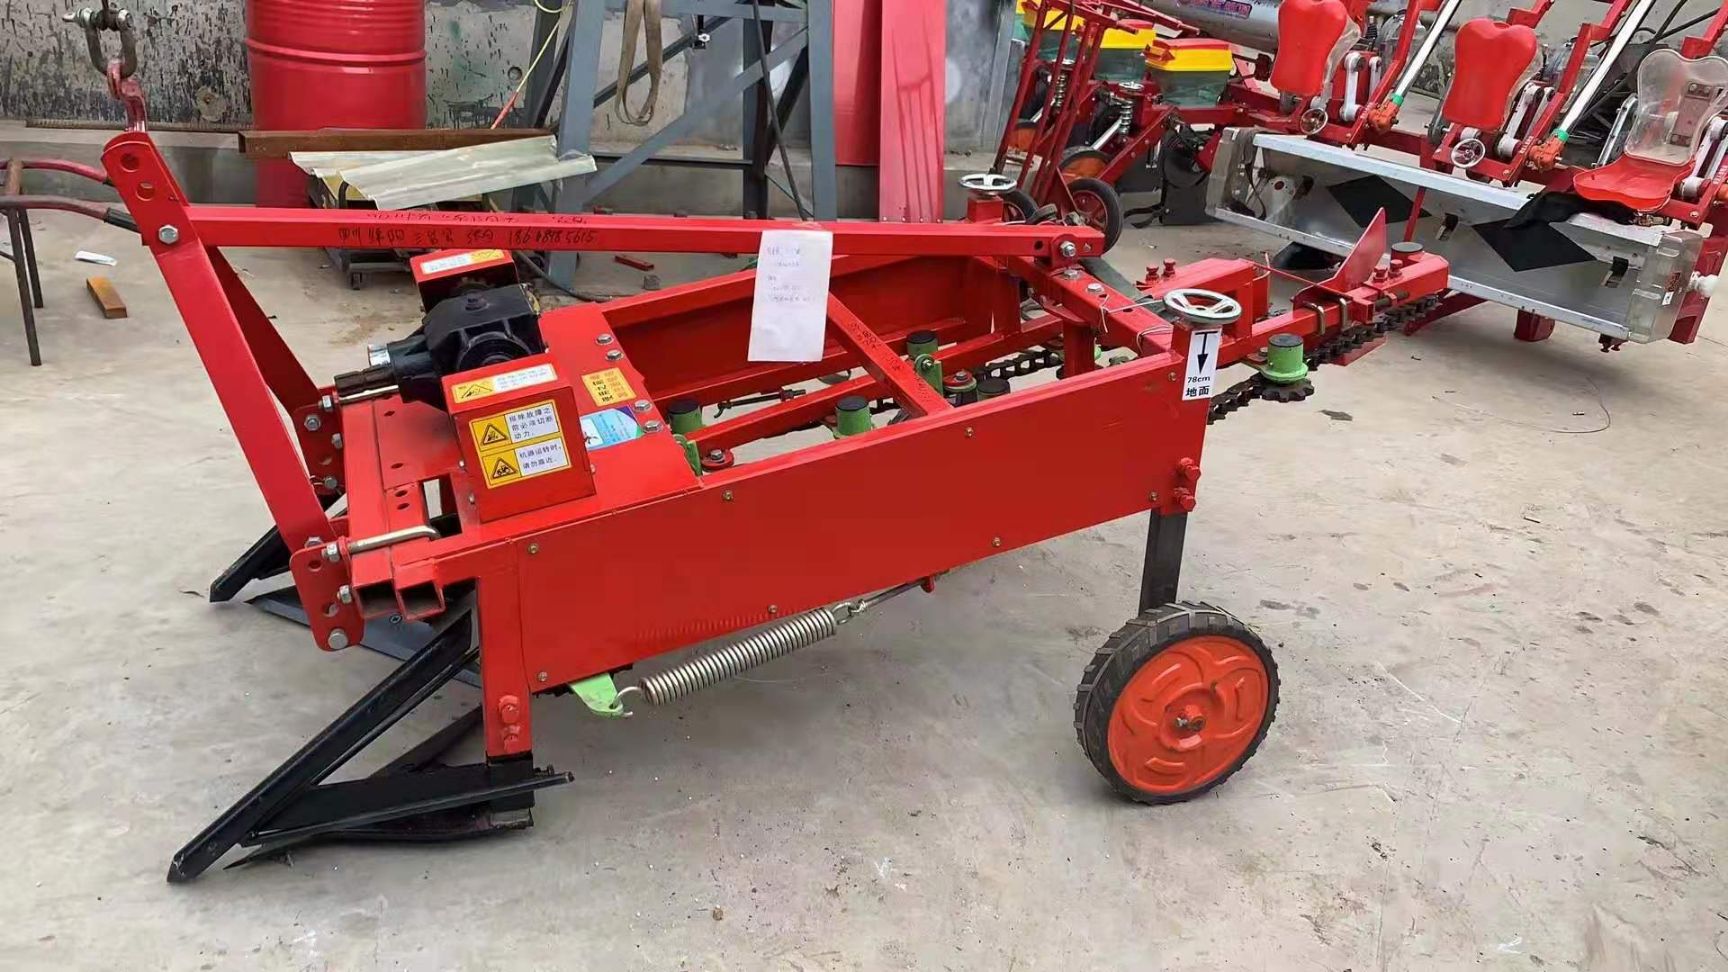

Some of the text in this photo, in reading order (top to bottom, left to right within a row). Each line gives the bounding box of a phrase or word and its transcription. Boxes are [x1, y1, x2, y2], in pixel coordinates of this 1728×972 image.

[1187, 376, 1211, 384] 78cm
[1185, 386, 1210, 397] 地面
[509, 407, 552, 422] 排除故障之
